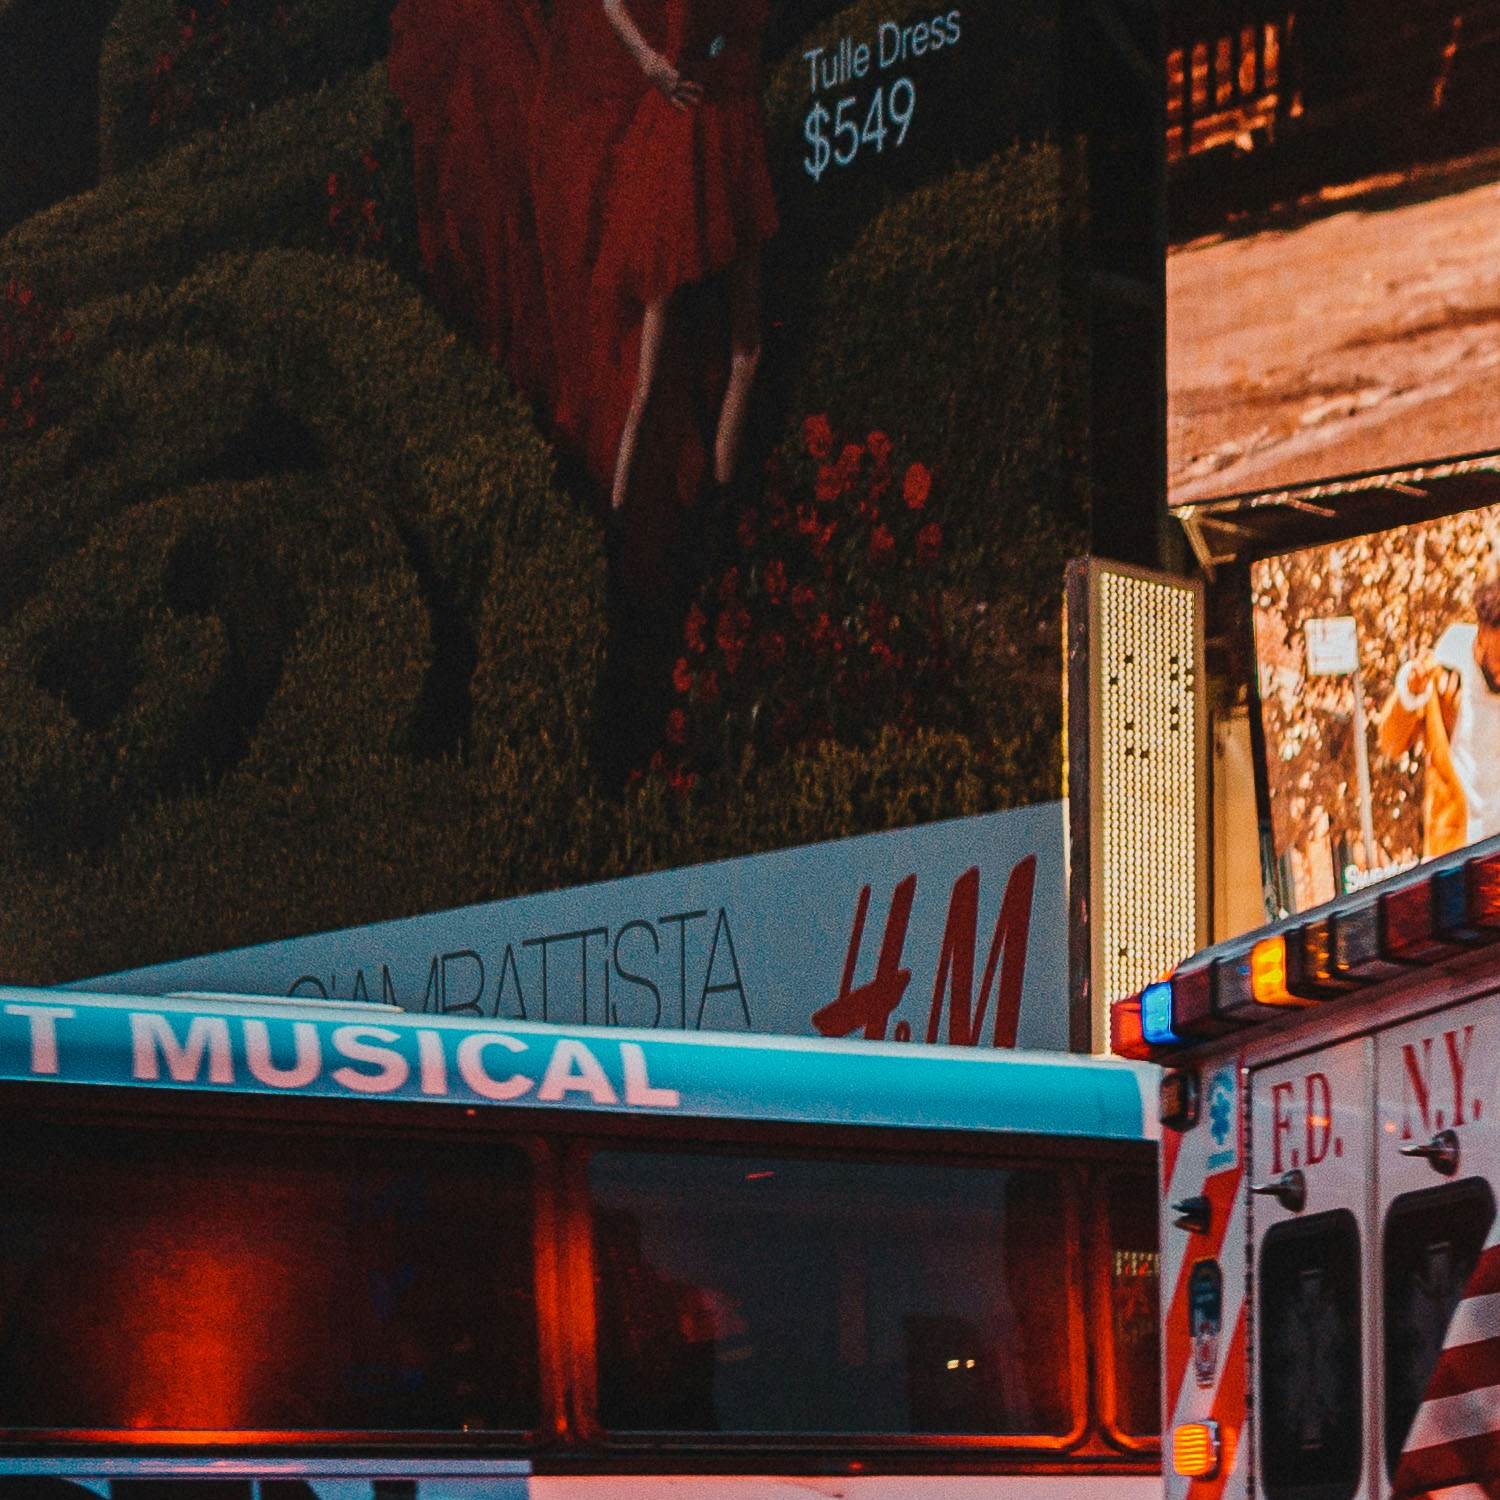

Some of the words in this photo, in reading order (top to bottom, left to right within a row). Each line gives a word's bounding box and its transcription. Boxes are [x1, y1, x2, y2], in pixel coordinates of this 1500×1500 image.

[803, 37, 870, 94] Tulle
[879, 9, 961, 69] Dress
[803, 77, 916, 182] $549
[4, 1004, 76, 1074] T
[129, 1012, 681, 1107] MUSICAL
[1271, 1072, 1344, 1175] F.D.
[1401, 1025, 1482, 1140] N.Y.
